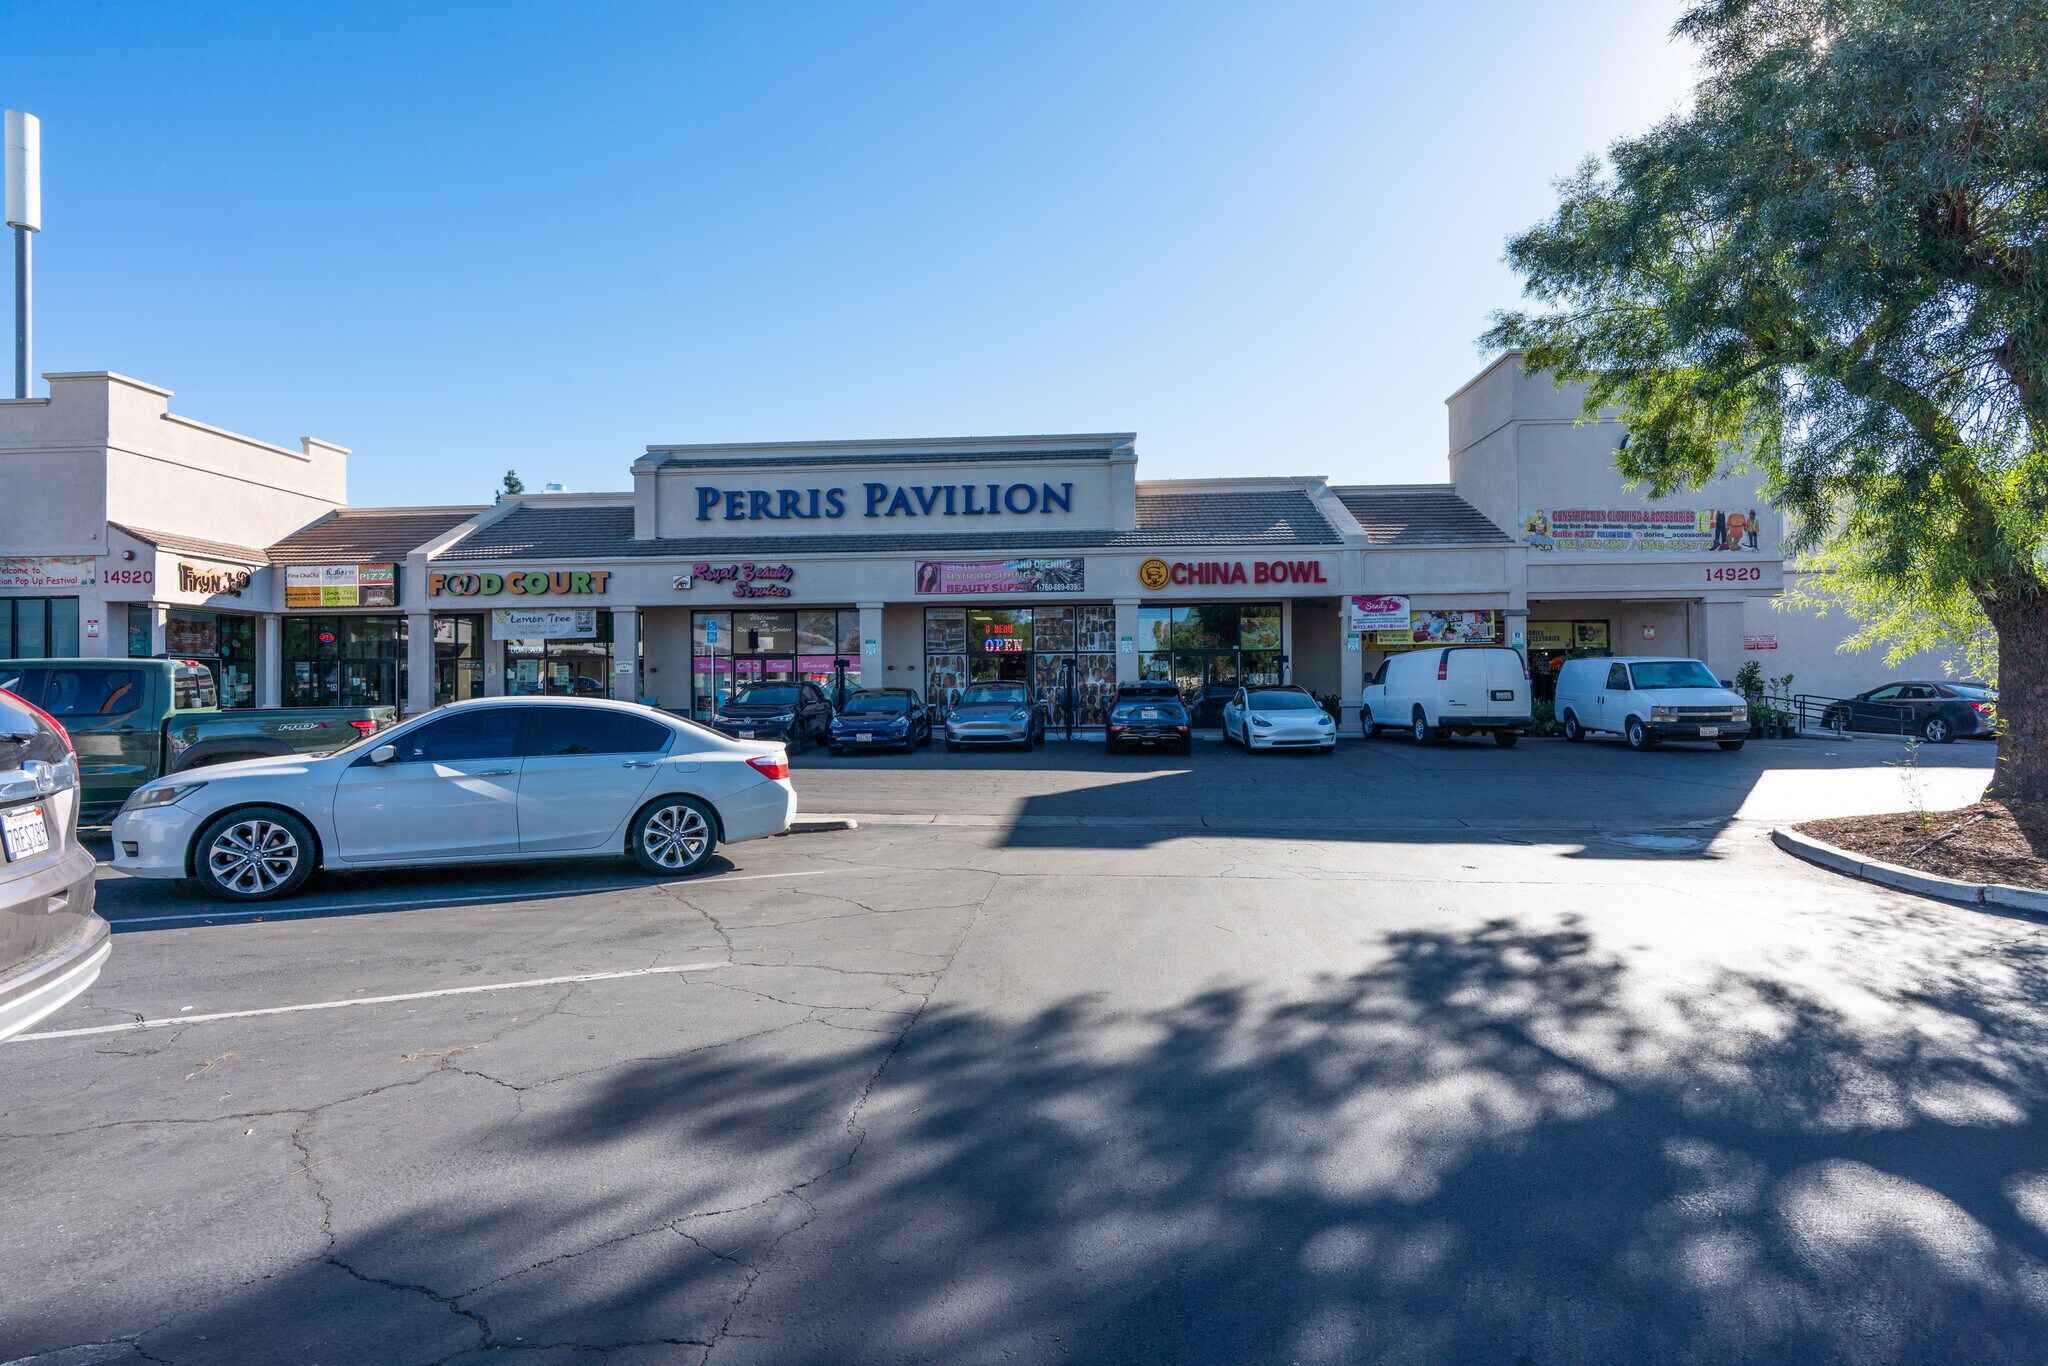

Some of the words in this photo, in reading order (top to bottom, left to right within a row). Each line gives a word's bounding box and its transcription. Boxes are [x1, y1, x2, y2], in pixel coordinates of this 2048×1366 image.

[695, 486, 846, 521] PERRIS
[863, 482, 1074, 518] PAVILION
[1552, 510, 1606, 522] CONSTRUCTION
[1608, 510, 1642, 522] CLOTHING
[1644, 511, 1649, 522] &
[1003, 560, 1032, 570] GRAND
[1035, 559, 1071, 569] OPENING
[104, 570, 153, 584] 14920
[692, 563, 738, 584] Royal
[742, 562, 794, 582] Beauty
[946, 573, 972, 581] HAIR
[976, 572, 1030, 581] BRAIDING
[1172, 562, 1247, 585] CHINA
[1254, 560, 1327, 584] BOWL
[1706, 567, 1760, 581] 14920
[16, 577, 29, 586] Pop
[32, 577, 43, 586] Up
[46, 576, 77, 584] Festival
[429, 572, 502, 596] FOOD
[505, 571, 611, 595] COURT
[946, 584, 989, 592] BEAUTY
[992, 583, 1033, 592] SUPPLY
[732, 580, 791, 598] Services
[511, 614, 544, 623] Lemon
[548, 614, 572, 622] Tree
[985, 639, 1023, 652] OPEN
[802, 662, 830, 670] Beauty
[7, 821, 46, 852] 7RFS789
